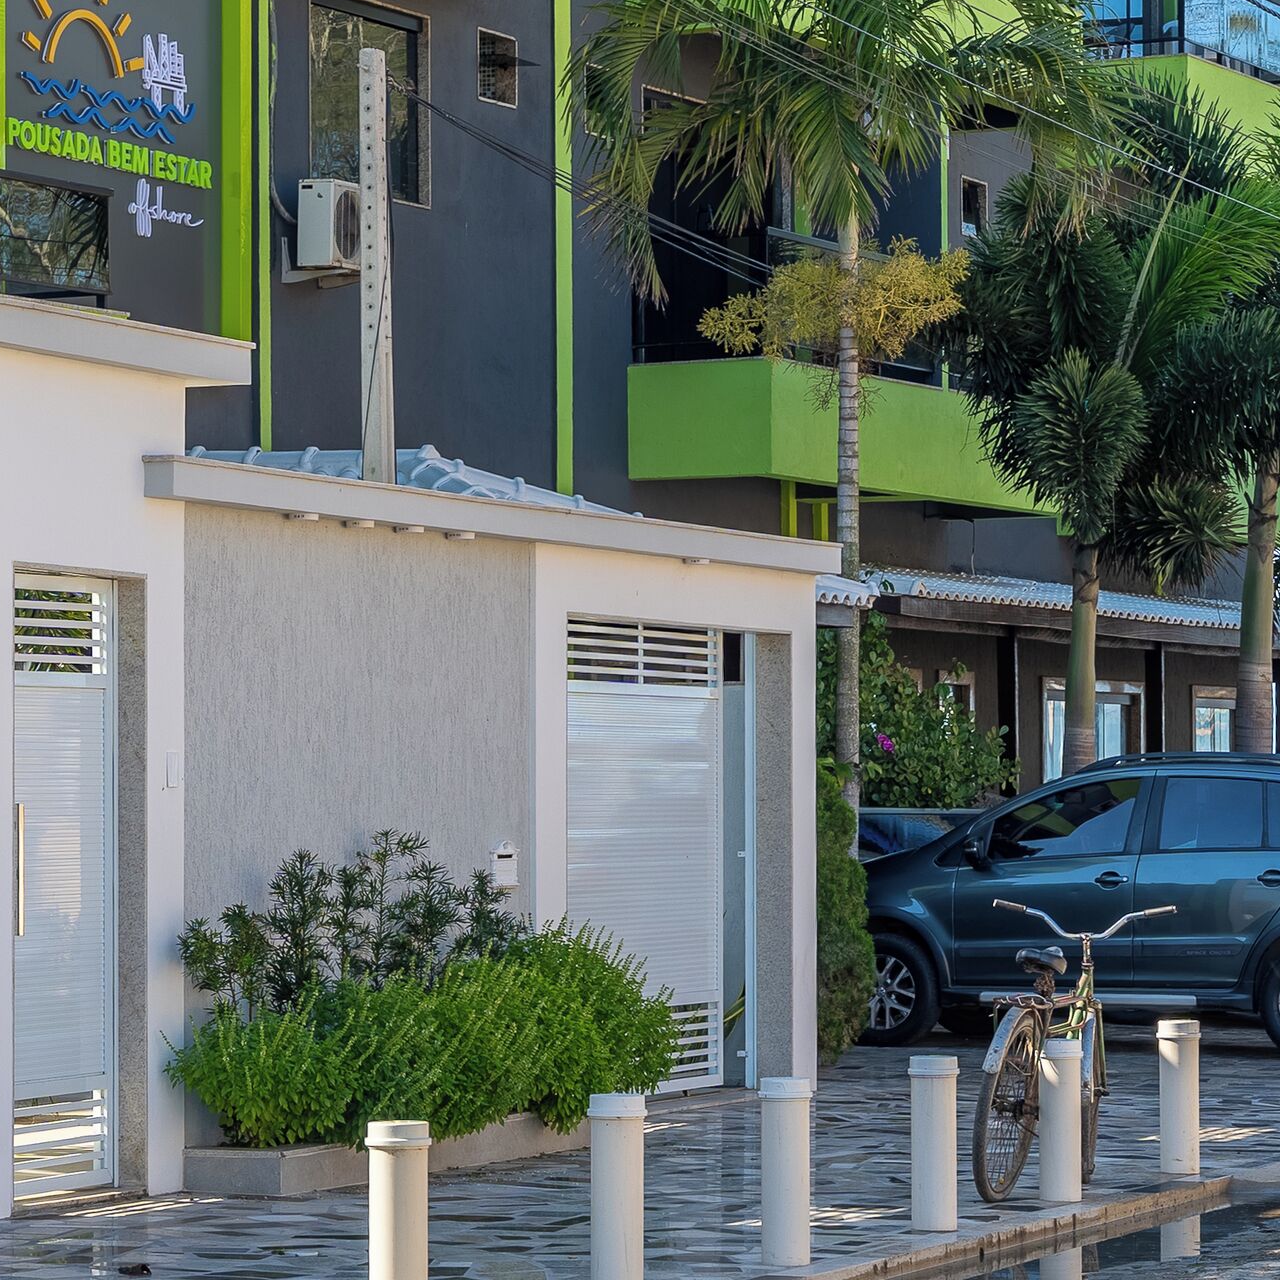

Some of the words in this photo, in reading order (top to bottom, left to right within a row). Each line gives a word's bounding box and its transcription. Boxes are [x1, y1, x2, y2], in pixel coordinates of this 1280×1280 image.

[6, 117, 103, 165] POUSADA
[107, 138, 149, 176] BEM
[152, 149, 212, 189] ESTAR
[128, 178, 204, 237] offshore
